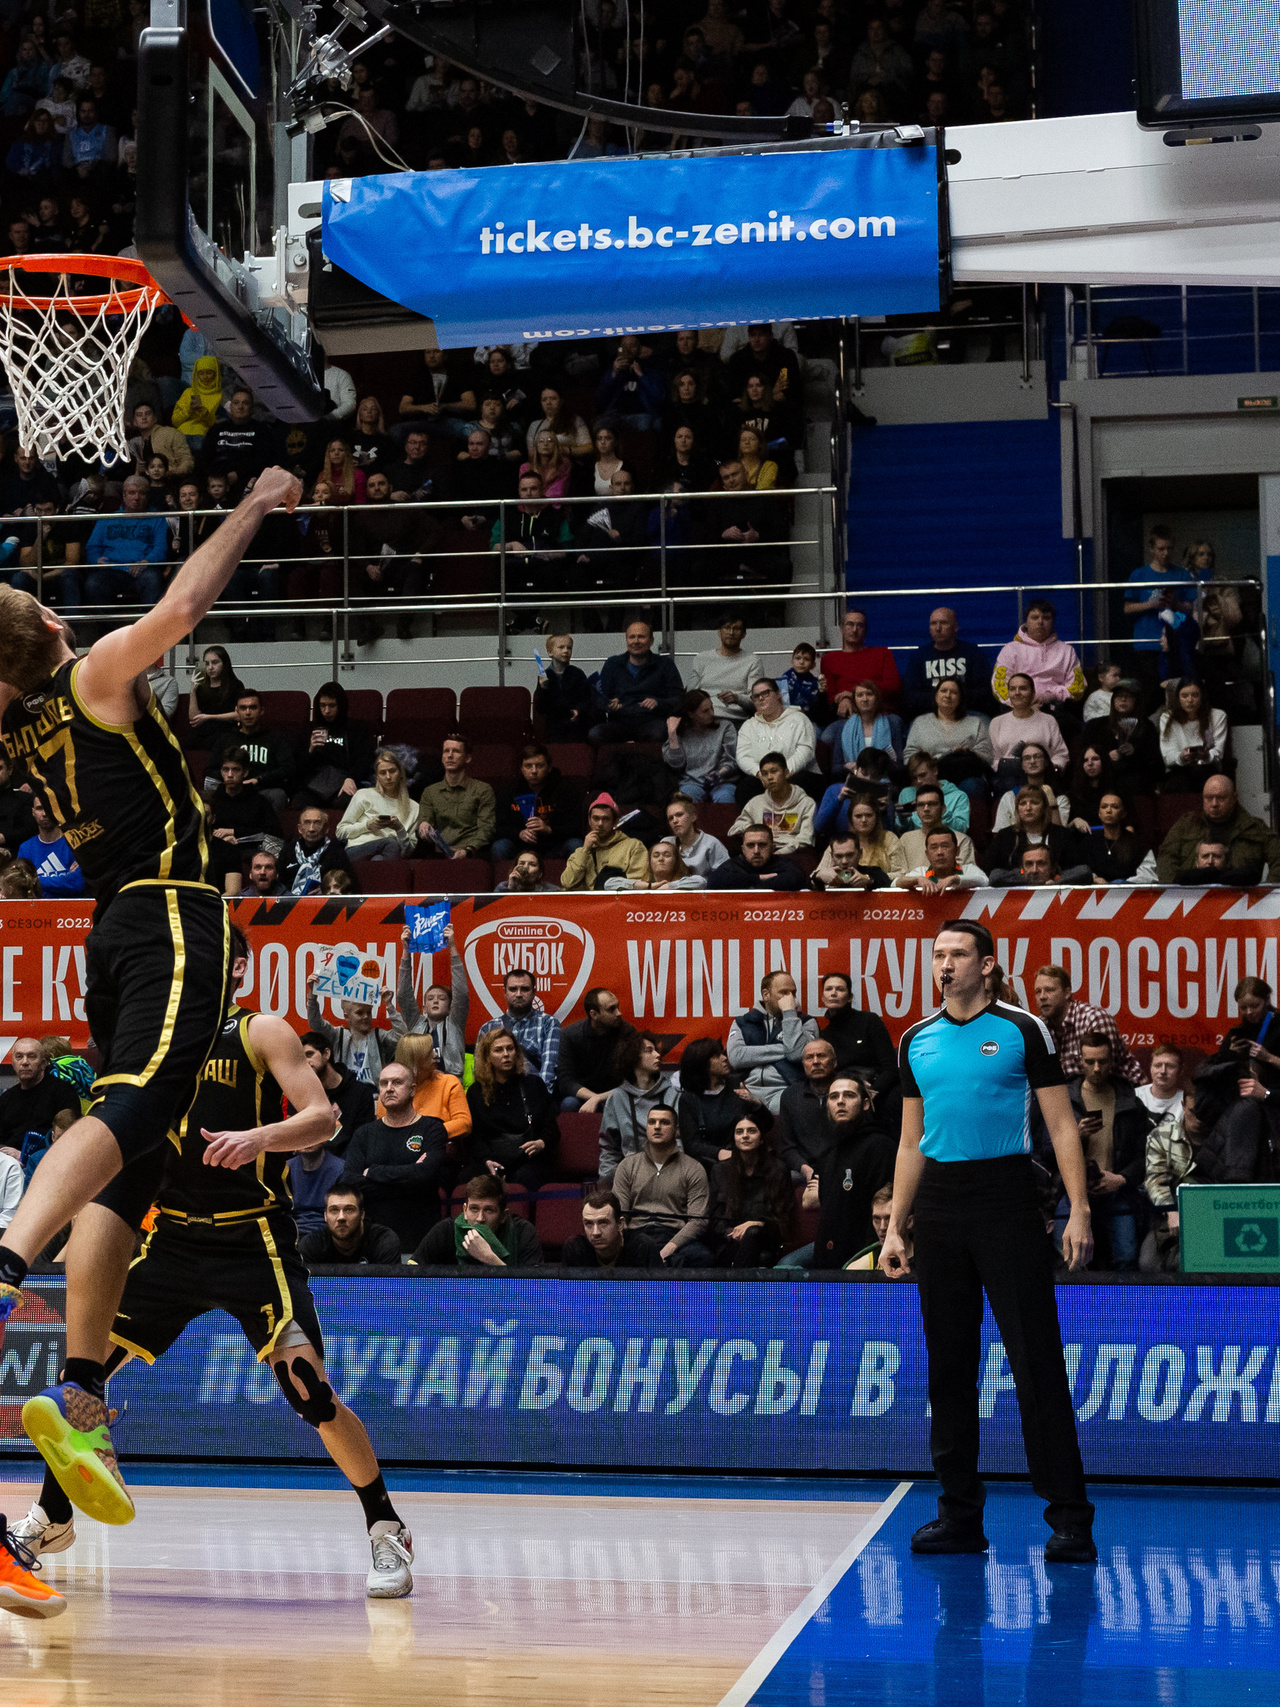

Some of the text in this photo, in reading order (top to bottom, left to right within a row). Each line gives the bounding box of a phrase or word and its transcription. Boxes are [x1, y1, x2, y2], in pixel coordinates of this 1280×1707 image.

[480, 210, 896, 254] tickets.bc-zenit.com
[925, 657, 966, 679] KISS
[26, 694, 46, 709] РФБ
[8, 918, 52, 929] СЕЗОН
[57, 918, 93, 928] 2022
[626, 909, 925, 923] 2022/23 СЕЗОН 2022/23 СЕЗОН 2022/23
[503, 926, 544, 936] Winline
[493, 942, 565, 976] КУБОК
[850, 937, 1030, 1018] КУК
[1051, 936, 1277, 1018] РОССИИ
[1122, 1033, 1155, 1045] 2/23
[1159, 1033, 1210, 1045] СЕЗОН
[0, 1340, 58, 1387] Wi
[197, 1319, 1280, 1422] ПОУЧАЙ БОНУСЫ В РЛОЖ
